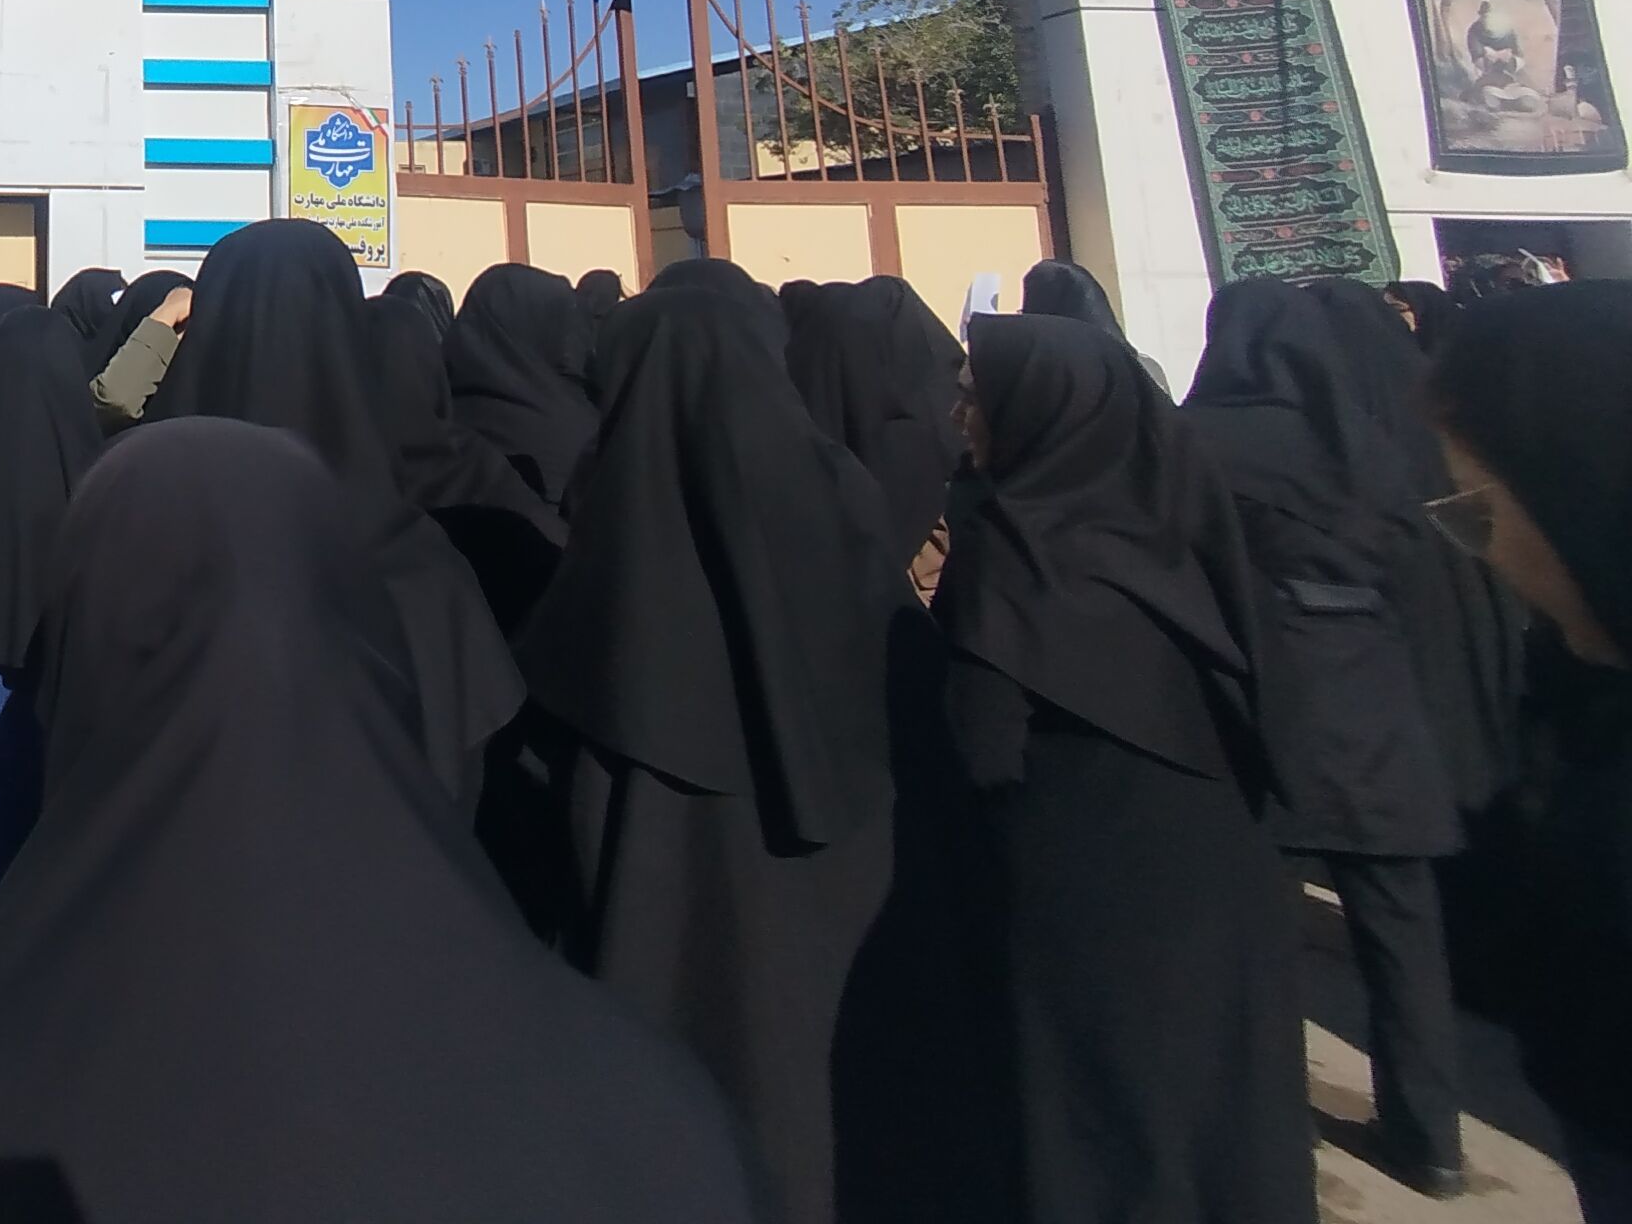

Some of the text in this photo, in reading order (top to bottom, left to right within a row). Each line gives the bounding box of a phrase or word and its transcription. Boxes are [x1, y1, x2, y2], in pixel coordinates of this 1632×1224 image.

[294, 192, 386, 210] دانشگاه ملی مهارت
[344, 235, 386, 263] پروفس
